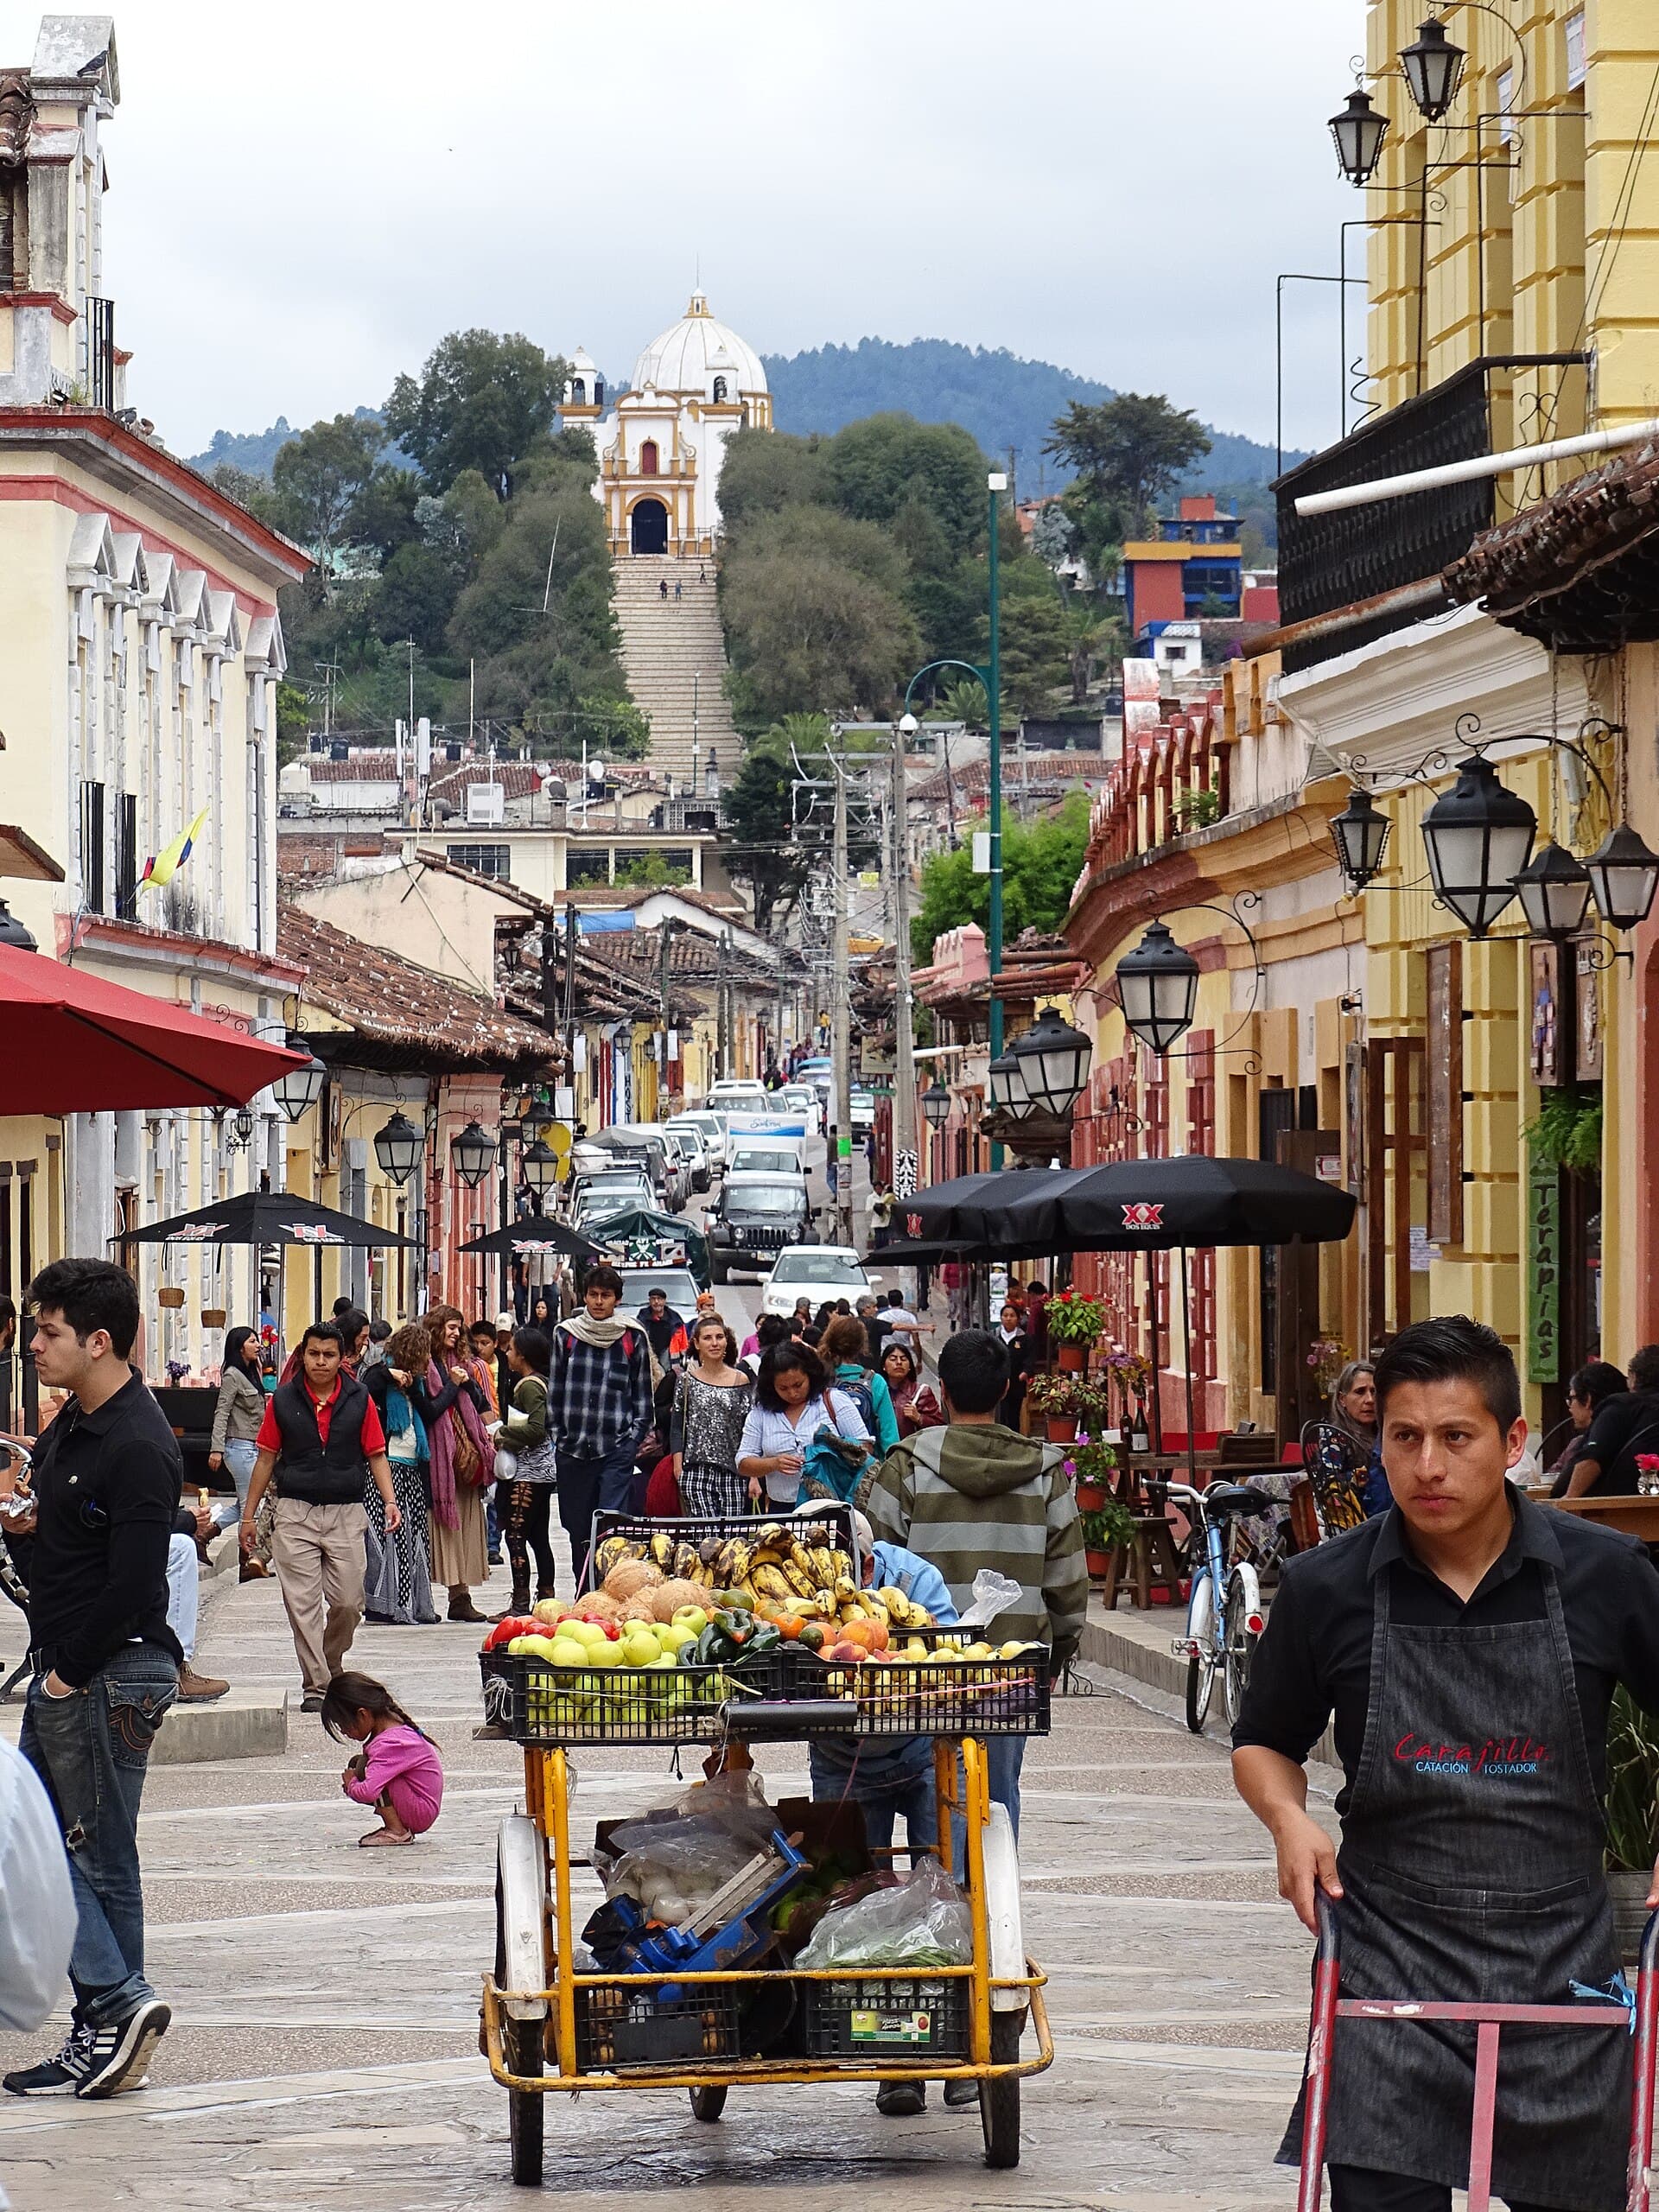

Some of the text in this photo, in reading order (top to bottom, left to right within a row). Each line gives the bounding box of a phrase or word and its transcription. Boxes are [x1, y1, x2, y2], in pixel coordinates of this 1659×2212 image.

[1121, 1205, 1165, 1224] XX
[1532, 1184, 1555, 1359] Terapias
[1415, 1761, 1537, 1774] CATACIÓN TOSTADOR
